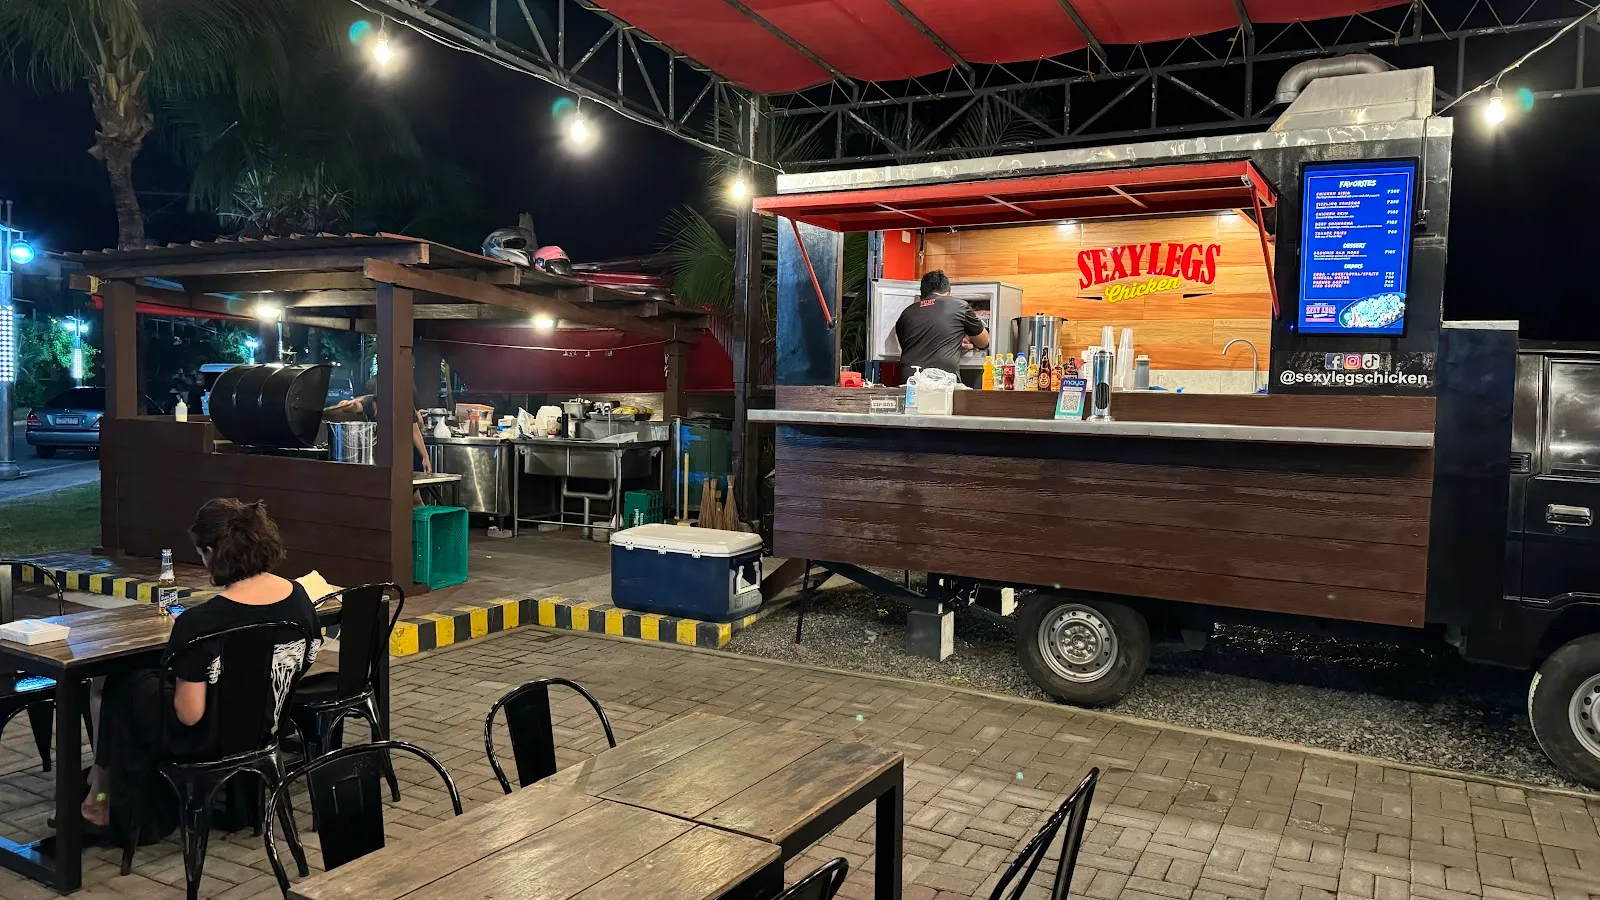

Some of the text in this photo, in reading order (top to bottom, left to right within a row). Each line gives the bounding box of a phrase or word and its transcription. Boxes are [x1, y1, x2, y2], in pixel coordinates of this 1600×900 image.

[1340, 180, 1377, 189] FAVORITES
[1077, 242, 1221, 290] SEXY LEGS
[1104, 277, 1181, 303] Chicken
[1306, 306, 1337, 315] SEXY LEGS
[1280, 370, 1428, 385] @sexylegschicken
